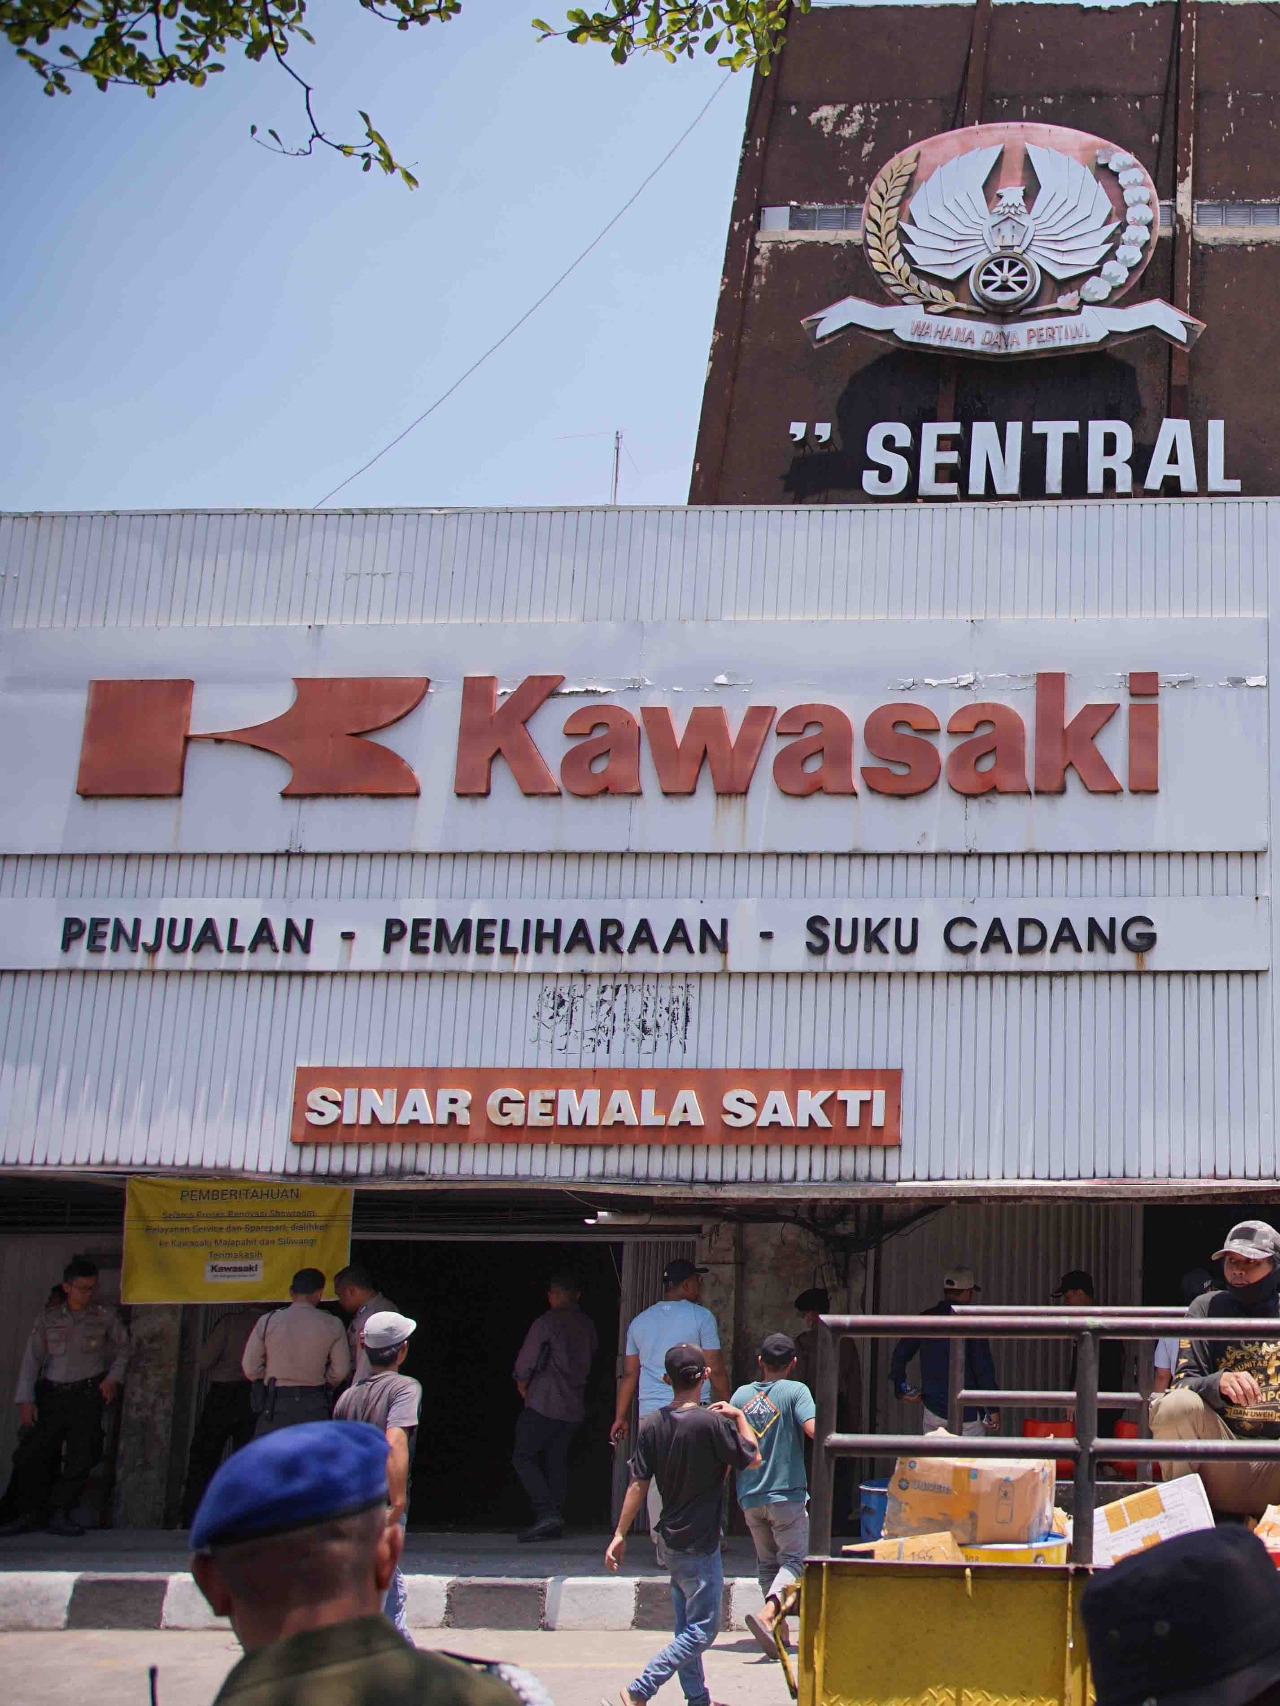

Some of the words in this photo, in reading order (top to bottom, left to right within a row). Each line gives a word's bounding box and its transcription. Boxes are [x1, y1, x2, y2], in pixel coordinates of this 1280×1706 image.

[910, 320, 975, 344] WAHANA
[981, 330, 1020, 347] DAYA
[861, 417, 1242, 497] SENTRAL
[454, 671, 1160, 797] Kawasaki
[60, 916, 314, 954] PENJUALAN
[383, 916, 728, 955] PEMELIHARAAN
[805, 915, 919, 955] SUKU
[943, 915, 1158, 954] CADANG
[304, 1086, 472, 1127] SINAR
[486, 1087, 705, 1128] GEMALA
[721, 1088, 885, 1128] SAKTI
[179, 1188, 300, 1201] PEMBERITAHUAN
[228, 1210, 267, 1218] Renovasi
[192, 1225, 224, 1233] Service
[226, 1224, 242, 1232] dan
[171, 1239, 212, 1247] Kawasaki
[214, 1238, 256, 1248] Majapahit
[259, 1238, 275, 1246] dan
[278, 1236, 317, 1248] Siliwangi
[210, 1263, 258, 1274] Kawasaki
